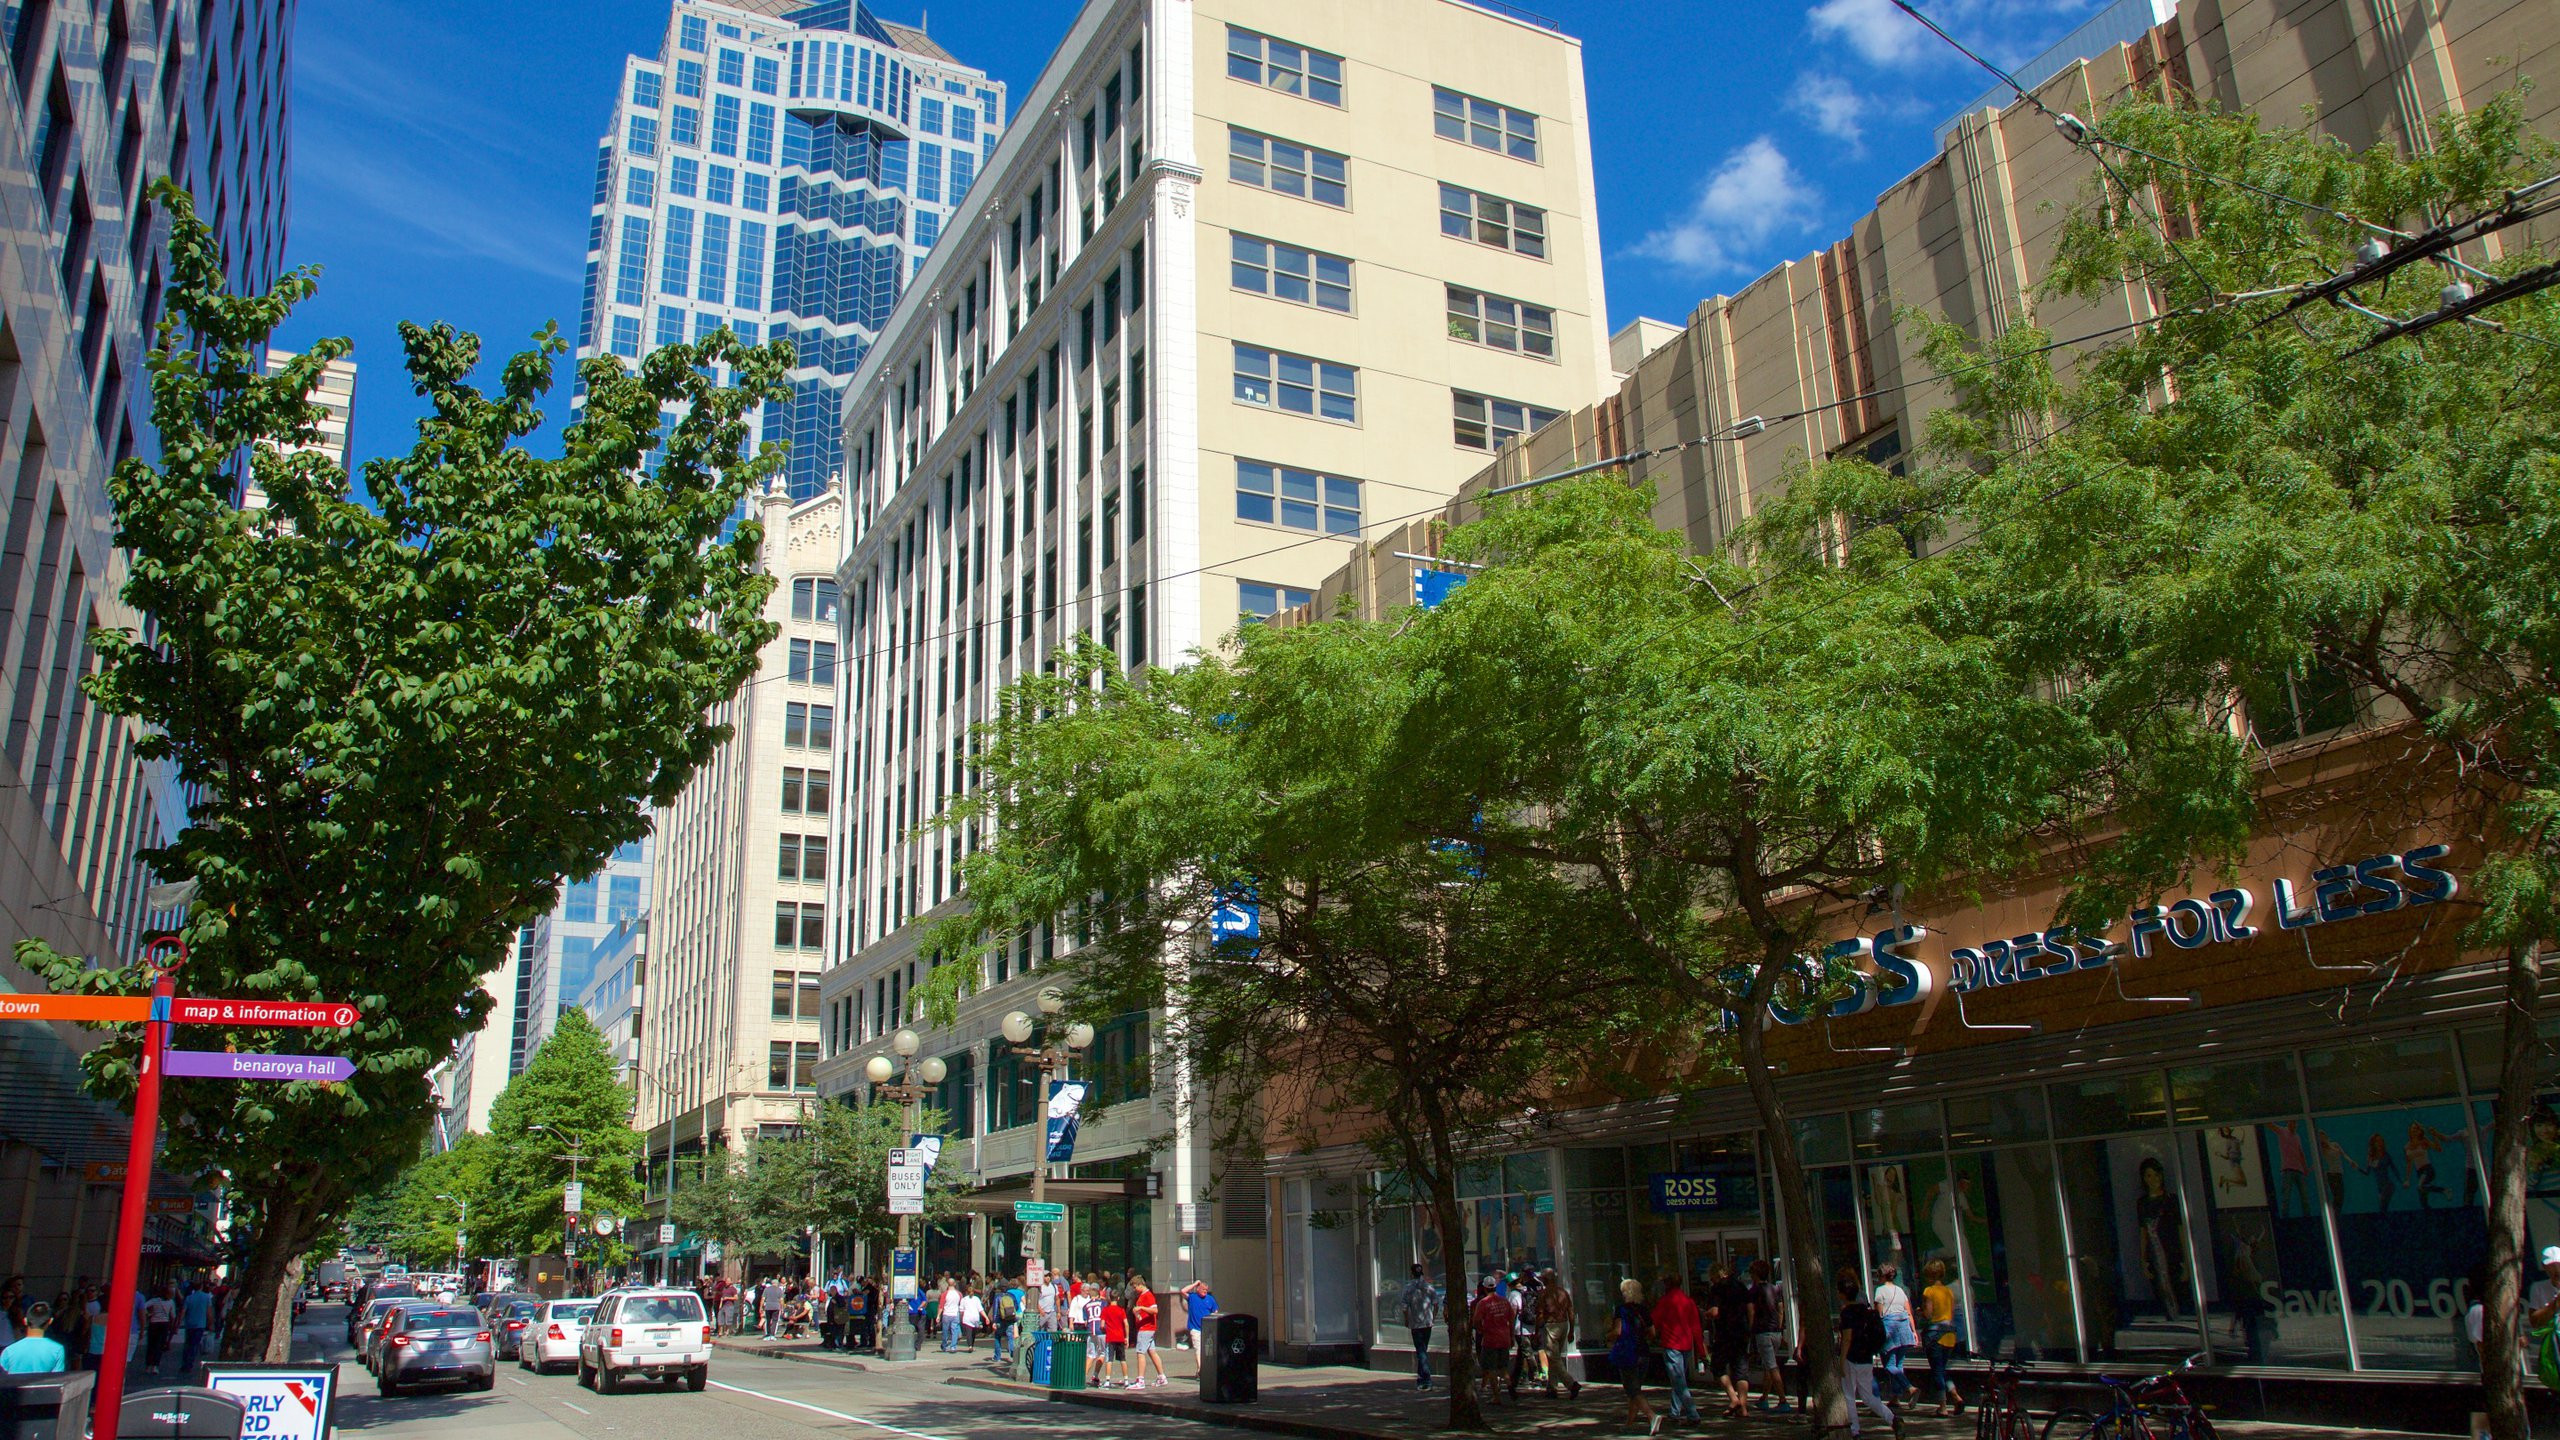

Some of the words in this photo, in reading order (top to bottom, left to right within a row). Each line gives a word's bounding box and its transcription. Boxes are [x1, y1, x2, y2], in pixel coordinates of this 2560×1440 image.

[1951, 920, 2118, 993] DRESS
[2131, 888, 2259, 958] FOR
[2273, 844, 2458, 931] LESS
[0, 1002, 40, 1013] town
[184, 1006, 218, 1020] map
[222, 1005, 235, 1019] &
[239, 1005, 327, 1021] information
[233, 1058, 303, 1076] benaroya
[308, 1061, 336, 1075] hall
[891, 1173, 921, 1181] BUSES
[894, 1182, 918, 1190] ONLY
[1665, 1178, 1717, 1197] ROSS
[2259, 1280, 2341, 1318] Save
[1087, 1305, 1102, 1319] 10
